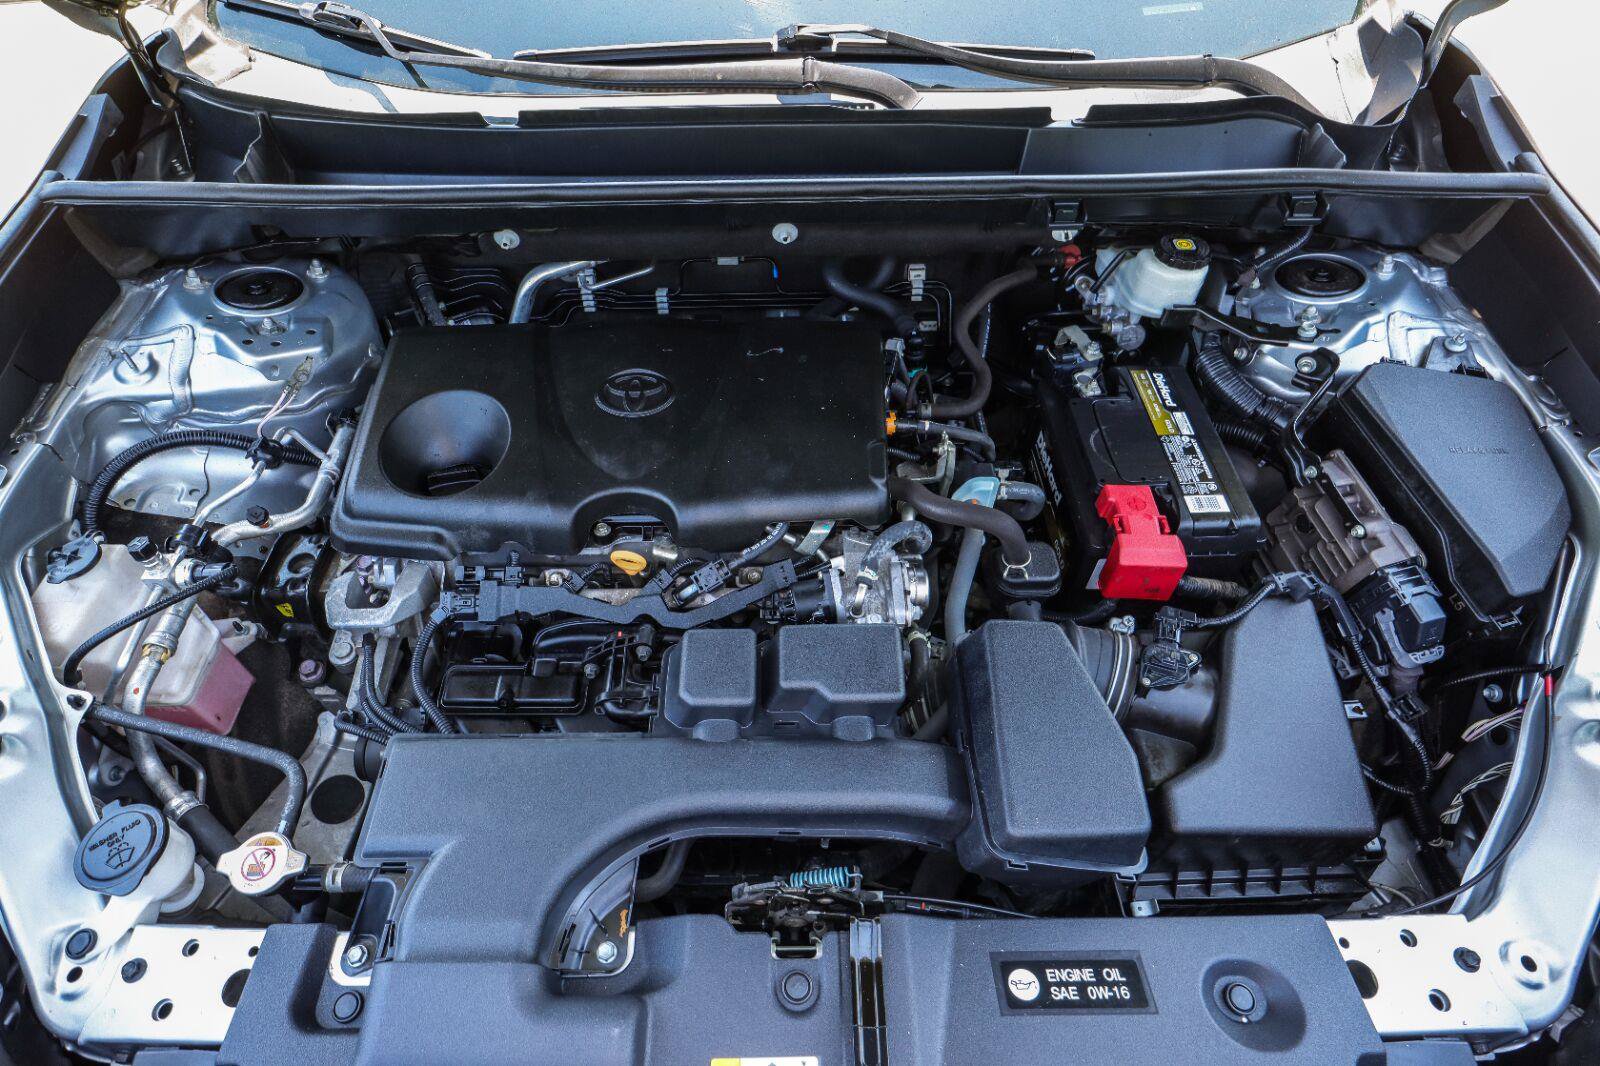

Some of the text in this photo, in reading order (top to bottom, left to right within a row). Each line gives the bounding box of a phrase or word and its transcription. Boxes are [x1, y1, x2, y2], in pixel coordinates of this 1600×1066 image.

[1152, 372, 1177, 407] DieHard
[1037, 429, 1062, 507] DieHard
[1045, 967, 1126, 982] ENGINE OIL
[1051, 985, 1131, 1000] SAE 0W-16
